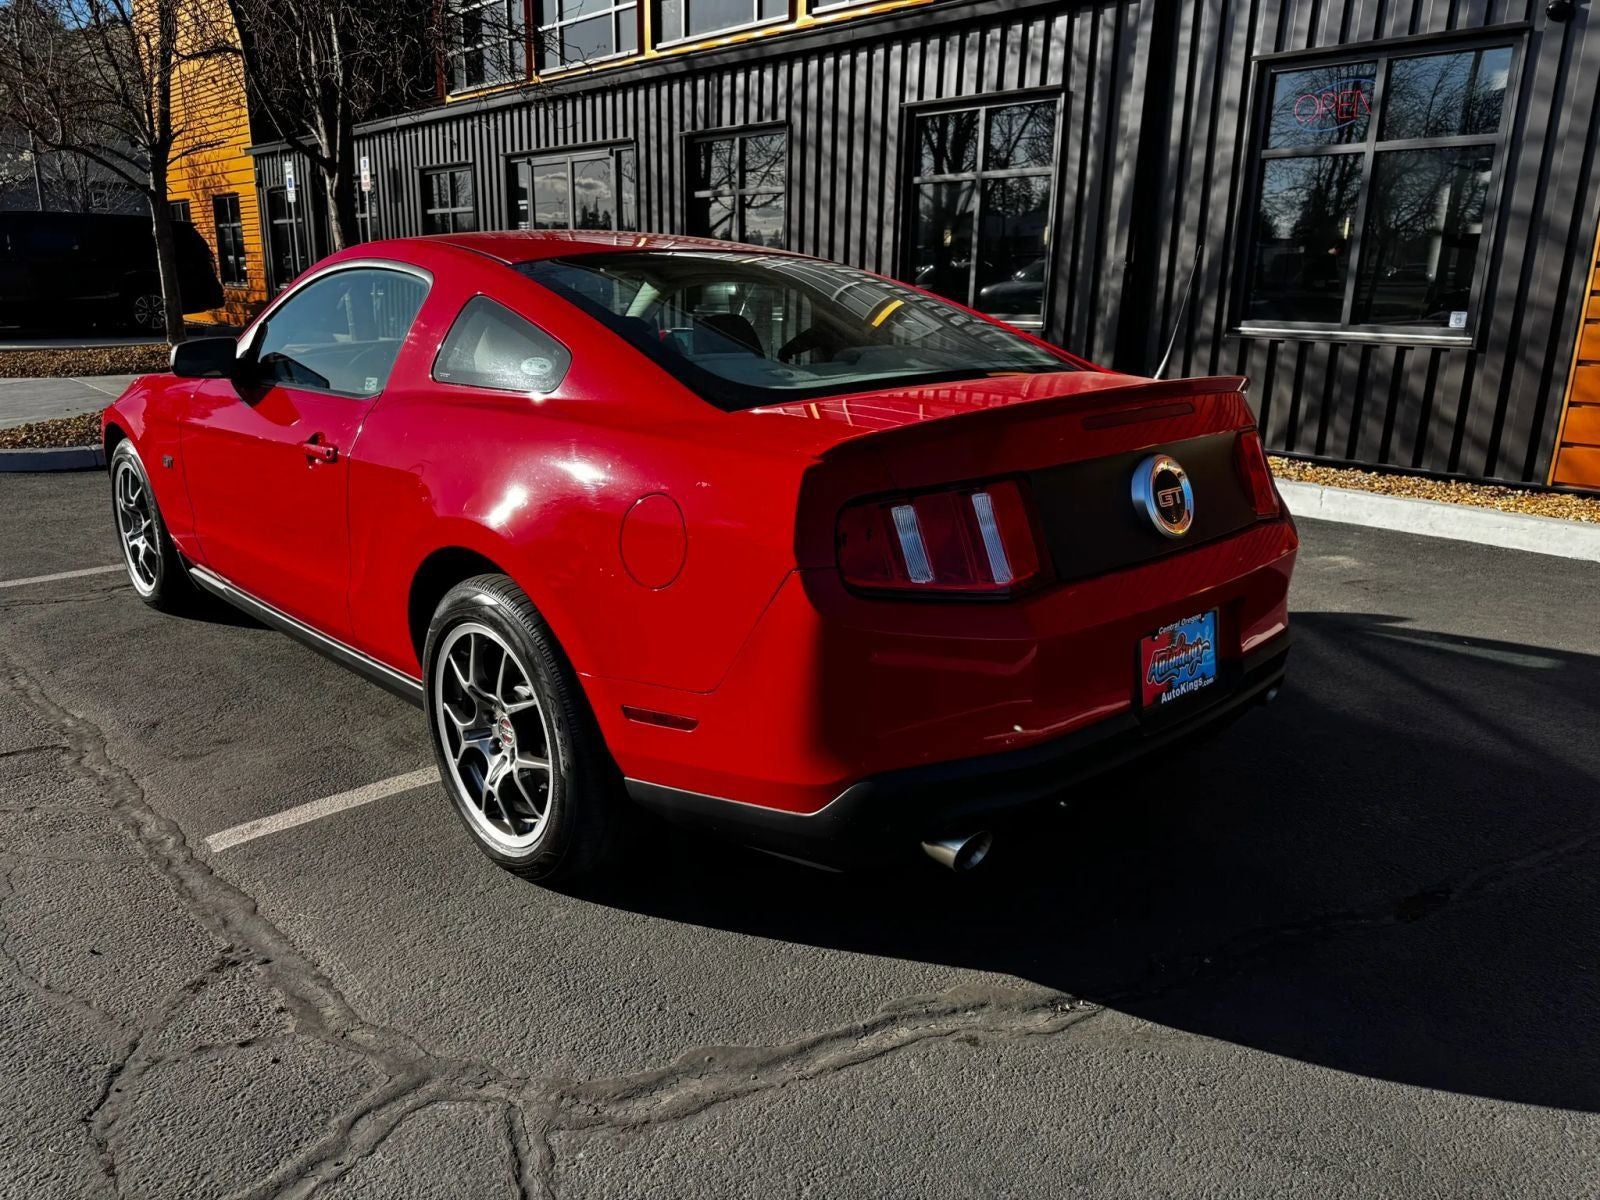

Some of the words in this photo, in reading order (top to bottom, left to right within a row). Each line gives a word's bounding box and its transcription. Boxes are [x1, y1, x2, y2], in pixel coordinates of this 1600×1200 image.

[1294, 90, 1372, 122] OPEN
[1157, 487, 1182, 507] GT
[1158, 619, 1180, 635] Central
[1161, 677, 1215, 704] AutoKings.com
